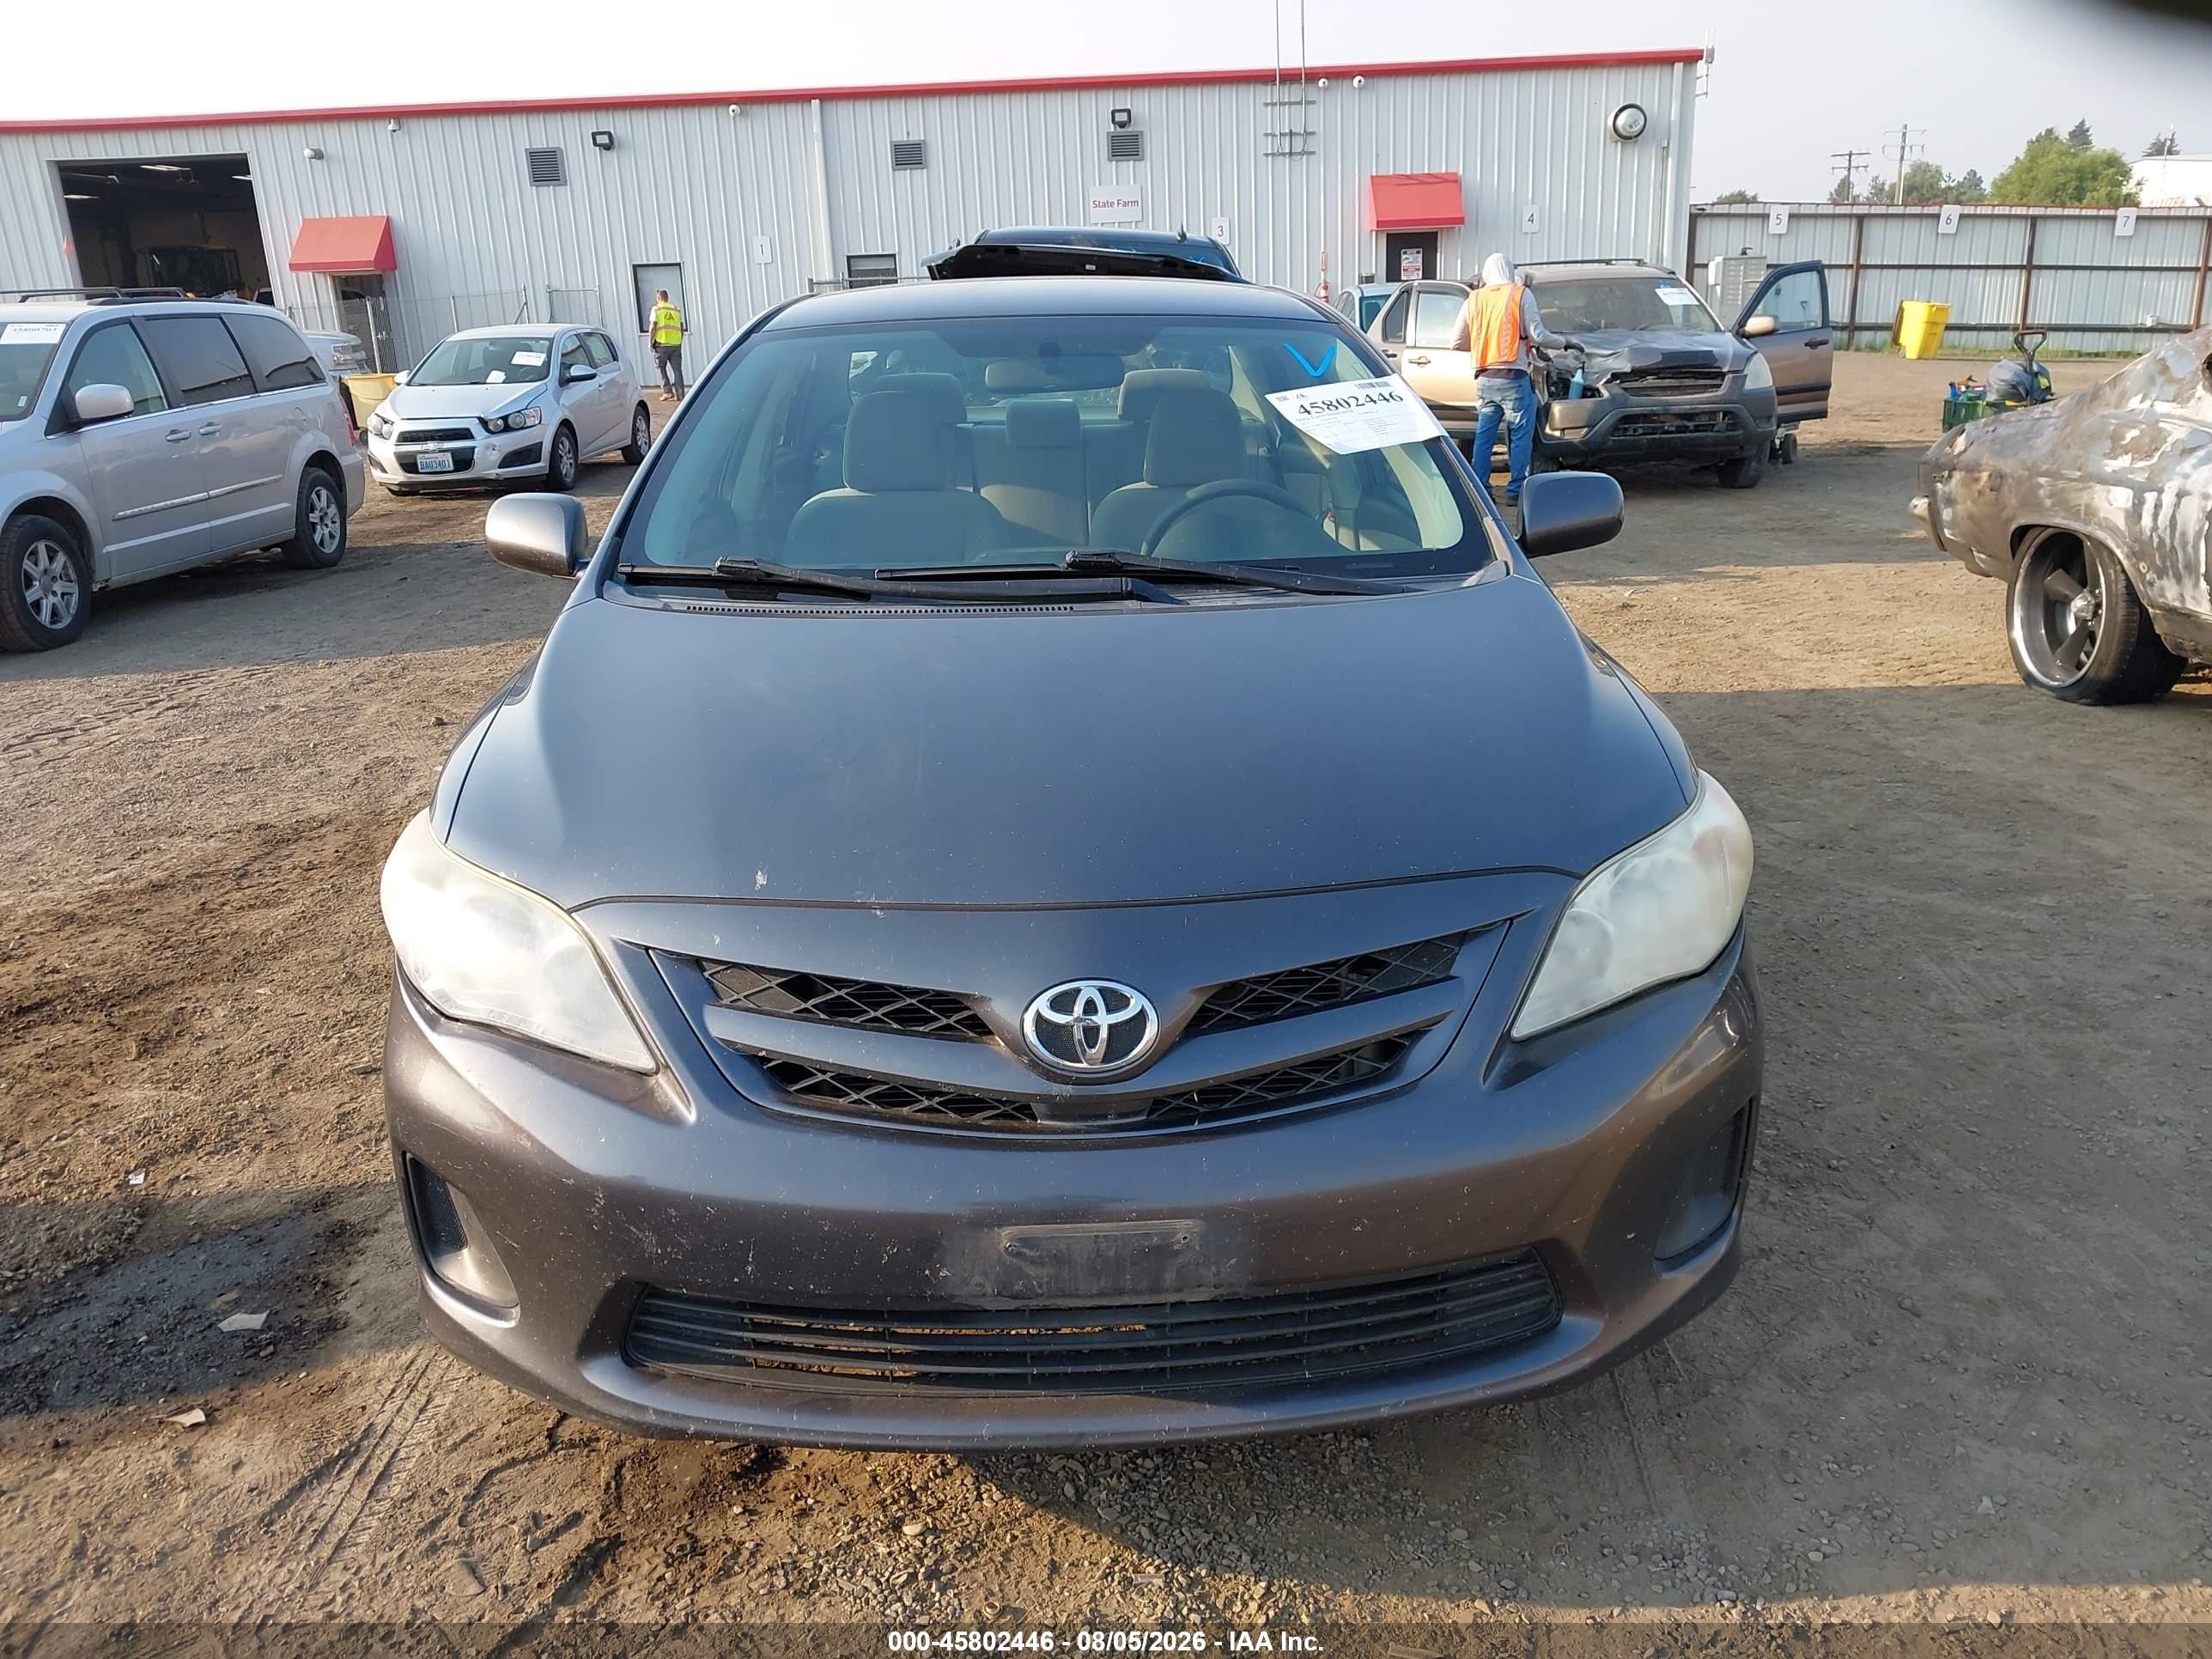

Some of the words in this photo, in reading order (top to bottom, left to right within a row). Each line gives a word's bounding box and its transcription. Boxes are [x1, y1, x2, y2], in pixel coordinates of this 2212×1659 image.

[1092, 200, 1115, 209] State
[1528, 213, 1534, 224] 4
[1776, 213, 1783, 226] 5
[1945, 213, 1953, 225] 6
[2123, 216, 2130, 228] 7
[1217, 225, 1224, 237] 3
[1298, 390, 1404, 416] 45802446
